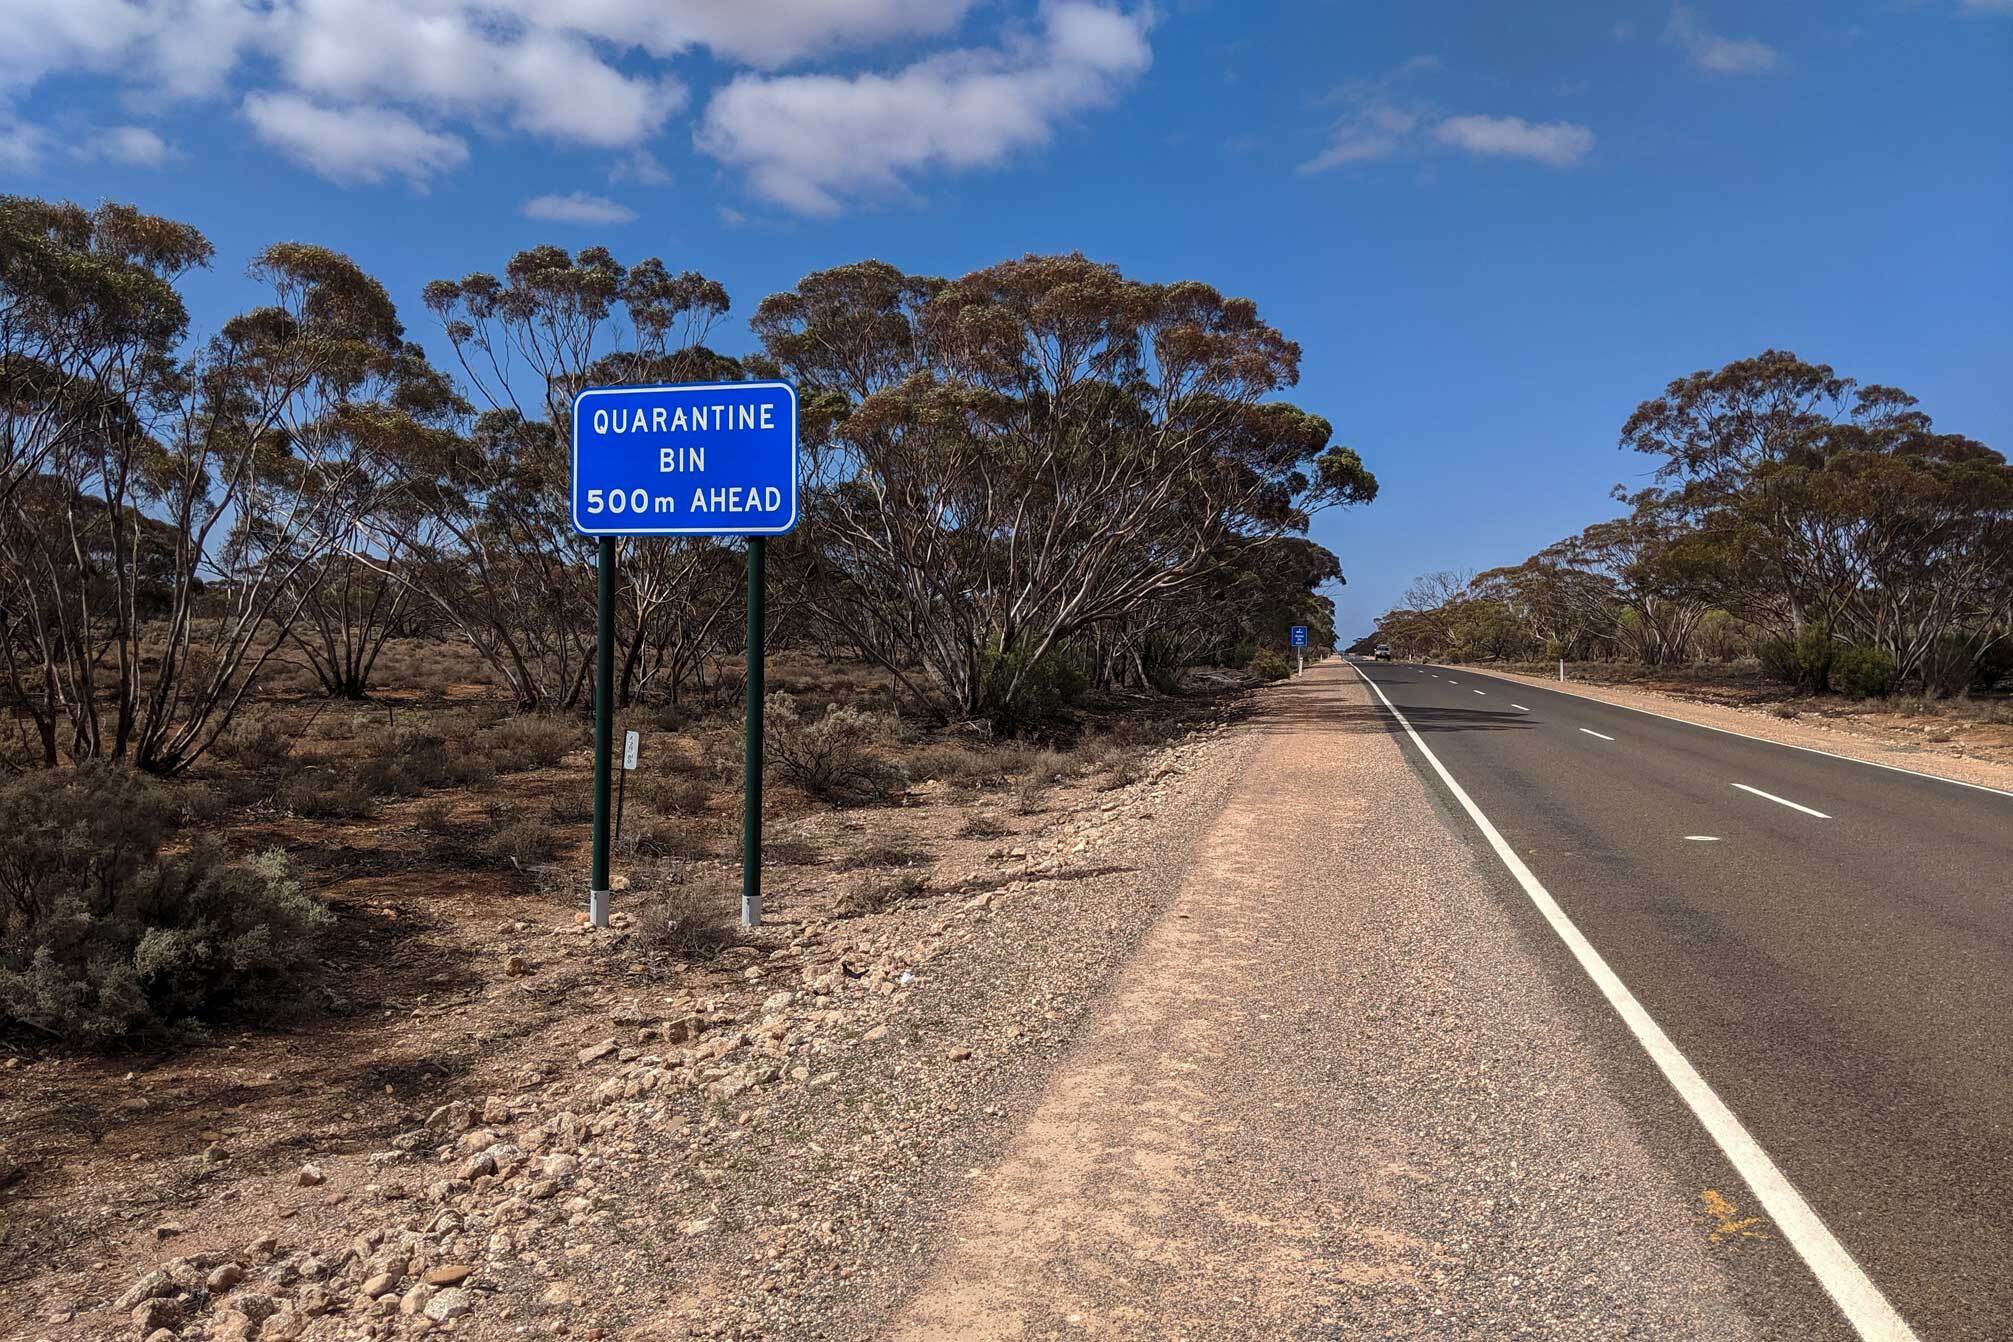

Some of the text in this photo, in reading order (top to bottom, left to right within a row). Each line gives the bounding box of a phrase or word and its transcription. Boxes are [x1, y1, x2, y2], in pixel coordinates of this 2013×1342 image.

[593, 403, 775, 434] QUARANTINE
[659, 447, 705, 473] BIN
[587, 486, 781, 514] 500m AHEAD
